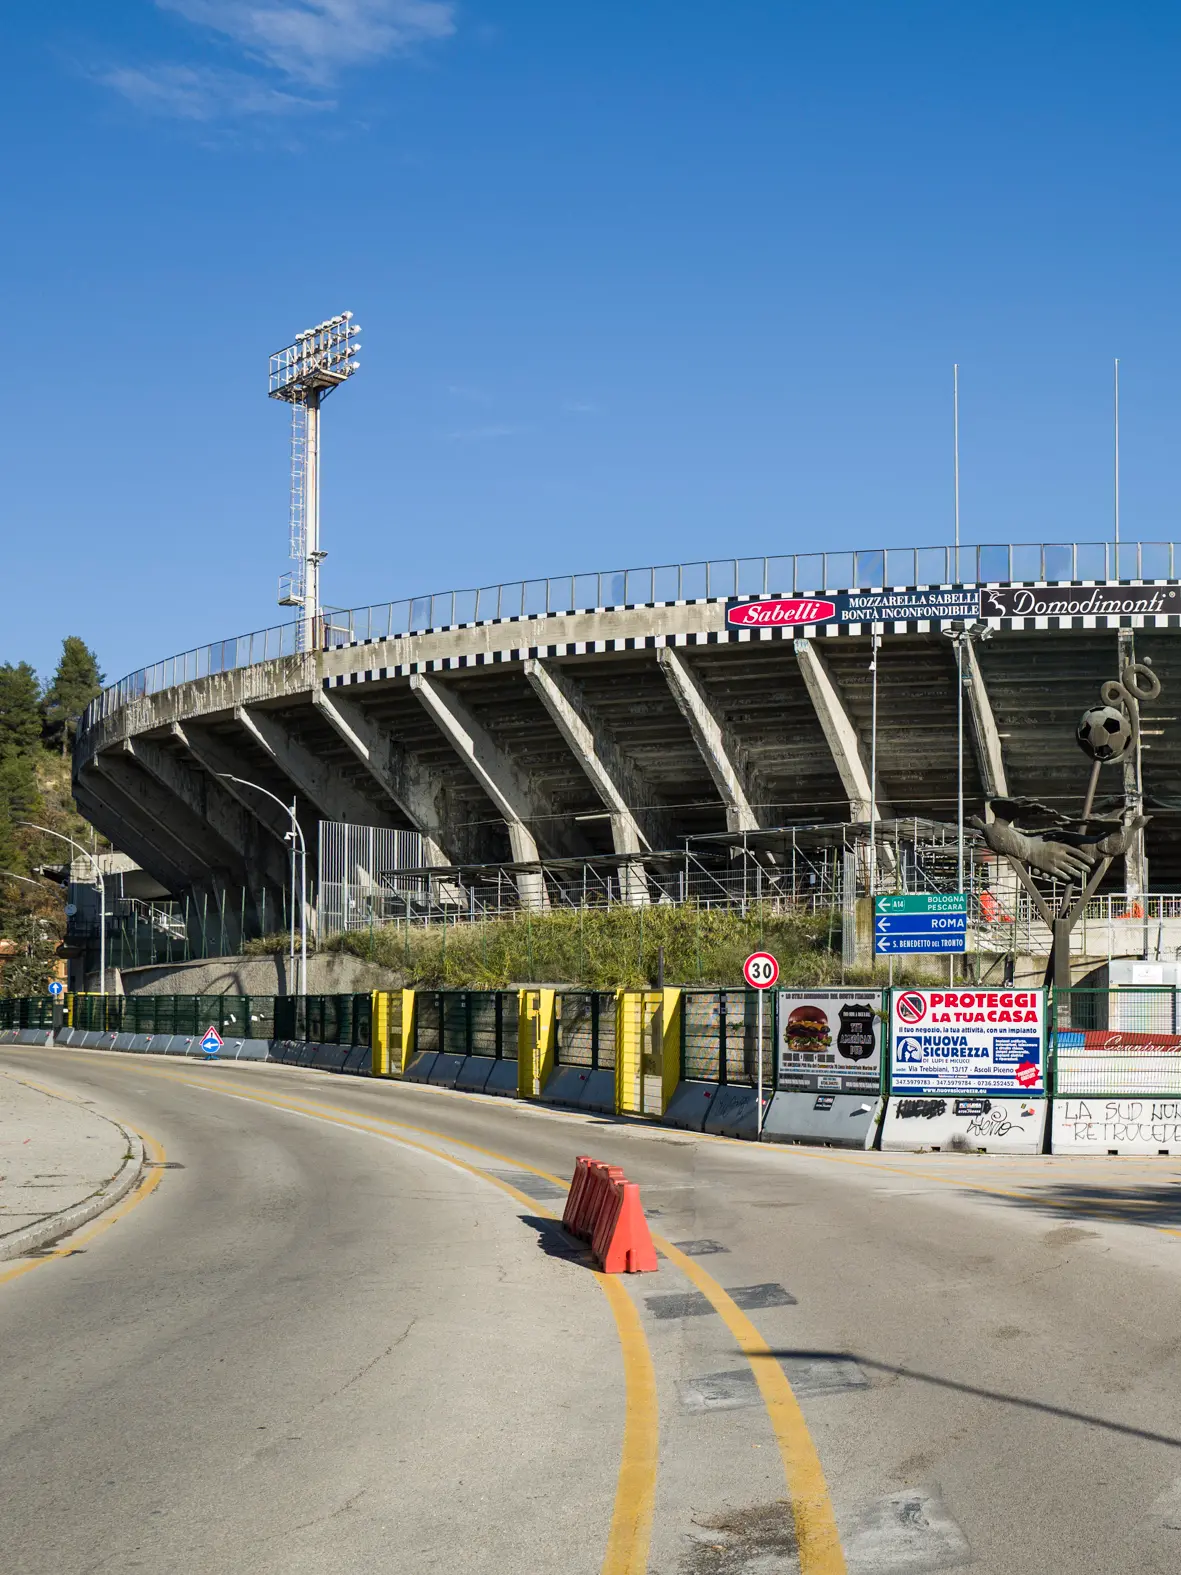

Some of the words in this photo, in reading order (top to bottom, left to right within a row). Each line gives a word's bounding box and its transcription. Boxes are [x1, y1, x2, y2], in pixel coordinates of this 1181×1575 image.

[849, 594, 928, 608] MOZZARELLA
[928, 592, 979, 604] SABELLI
[1012, 589, 1165, 615] Domodimonti
[743, 603, 820, 624] Sabelli
[841, 606, 878, 620] BONTÀ
[882, 605, 979, 618] INCONFONDIBILE
[931, 919, 964, 928] ROMA
[752, 963, 771, 978] 30
[930, 993, 1036, 1008] PROTEGGI
[932, 1013, 951, 1022] LA
[954, 1013, 986, 1022] TUA
[987, 1010, 1038, 1022] CASA
[924, 1036, 968, 1046] NUOVA
[923, 1047, 989, 1057] SICUREZZA
[1065, 1101, 1092, 1120] LA
[1106, 1102, 1143, 1122] SUD
